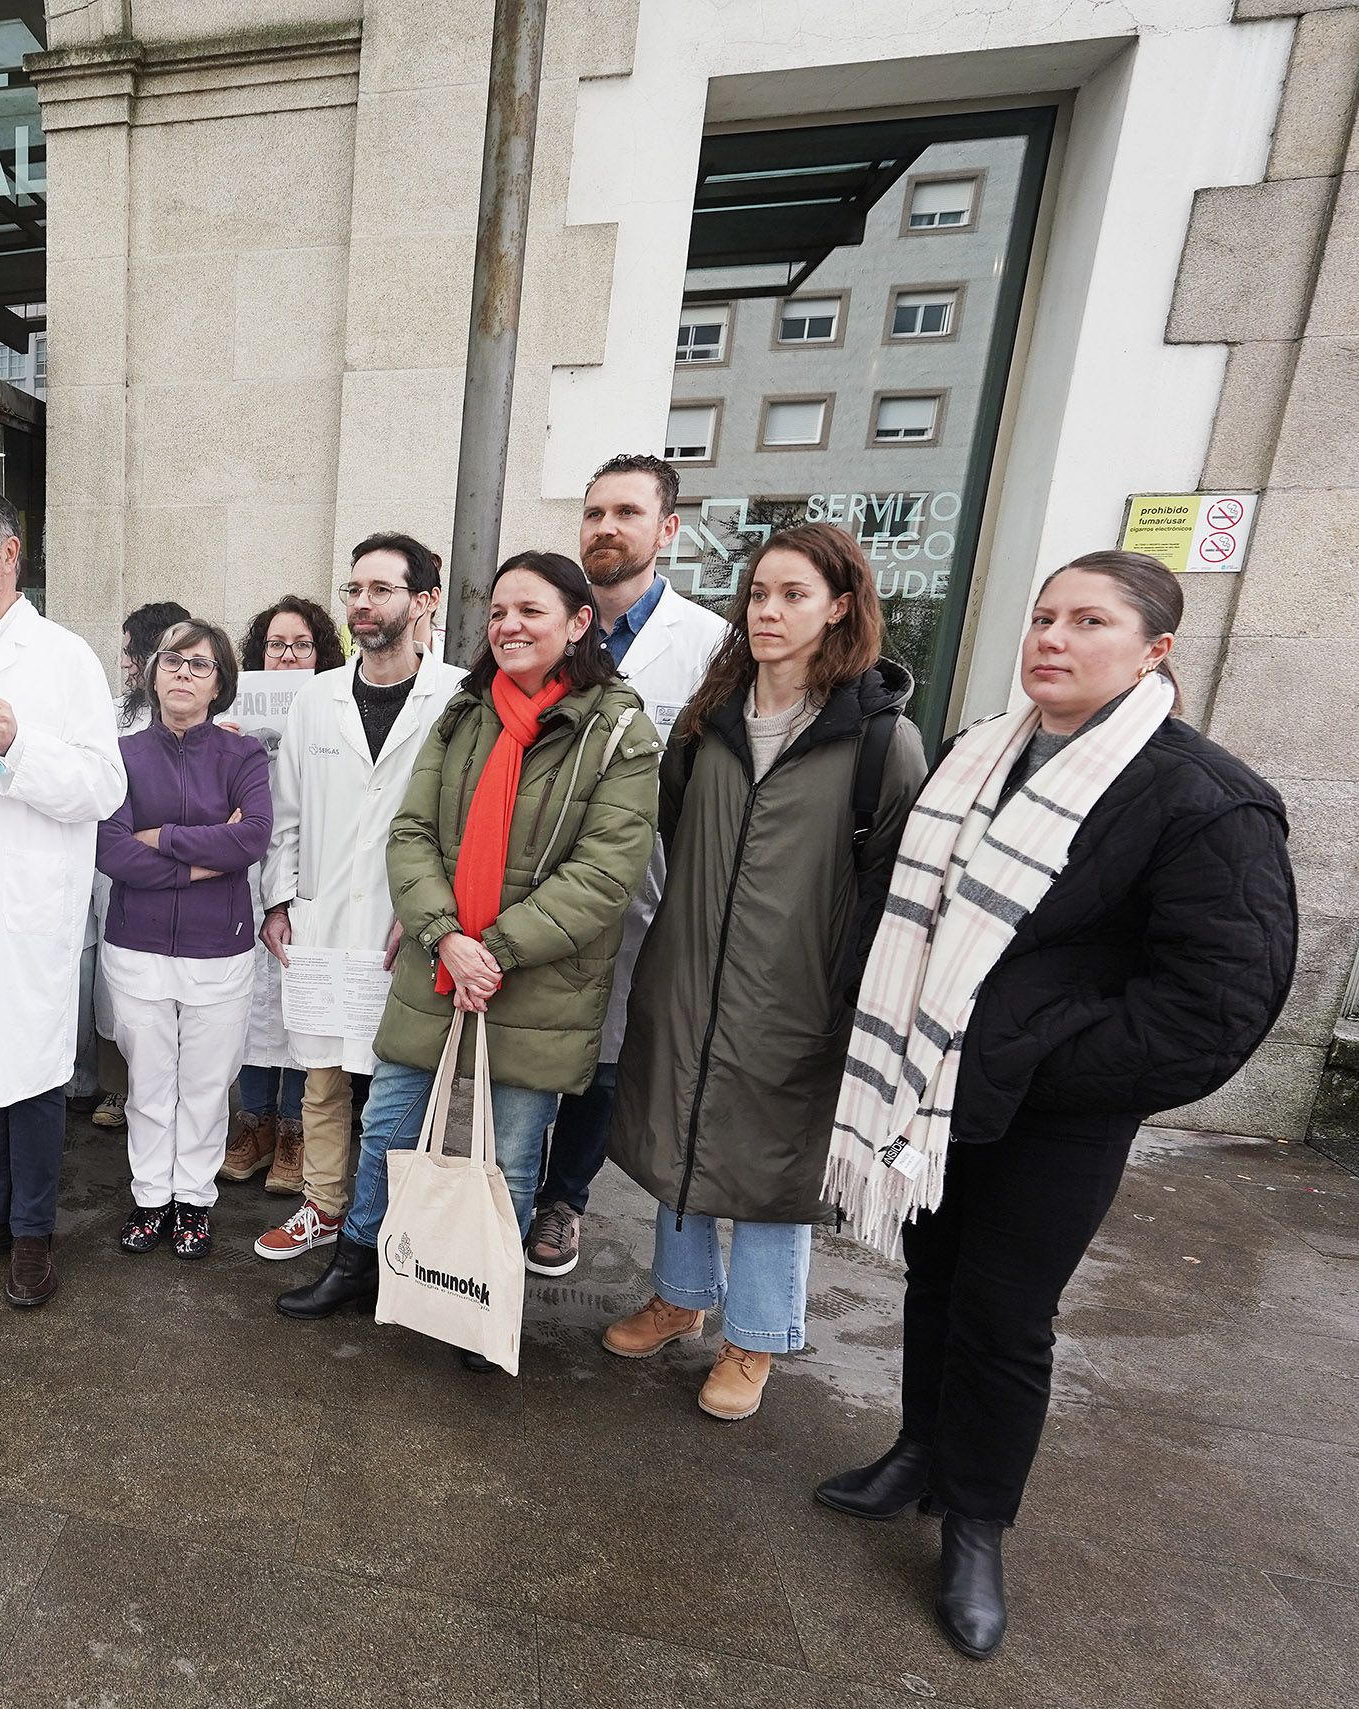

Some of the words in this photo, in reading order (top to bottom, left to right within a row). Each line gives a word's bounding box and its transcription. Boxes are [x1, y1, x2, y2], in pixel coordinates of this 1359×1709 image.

[805, 491, 962, 523] SERVIZO
[1141, 506, 1189, 516] prohibido
[876, 561, 951, 599] ÚDE
[883, 1138, 907, 1166] INSIDE
[415, 1259, 490, 1307] inmunotek
